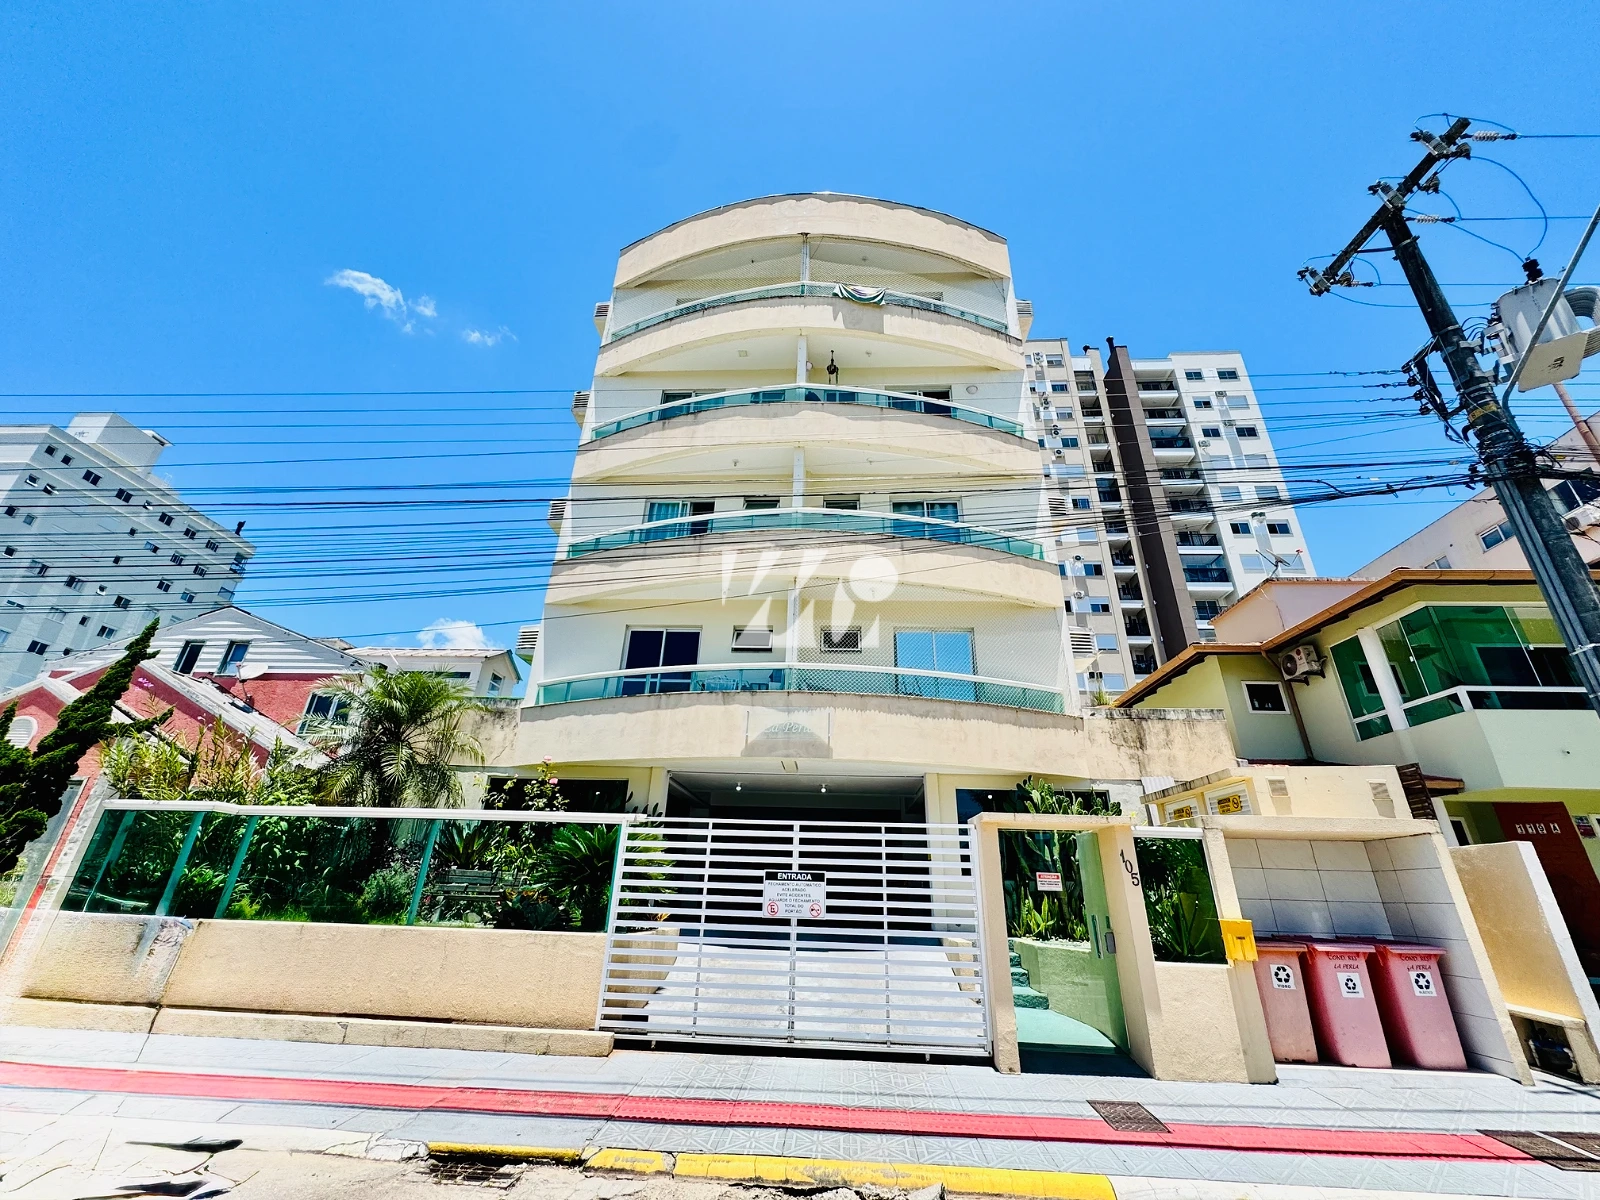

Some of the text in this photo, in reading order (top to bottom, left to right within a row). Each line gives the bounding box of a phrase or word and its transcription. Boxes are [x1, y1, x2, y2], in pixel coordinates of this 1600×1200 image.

[1516, 823, 1547, 834] 119
[1119, 849, 1140, 886] 105
[777, 872, 812, 880] ENTRADA
